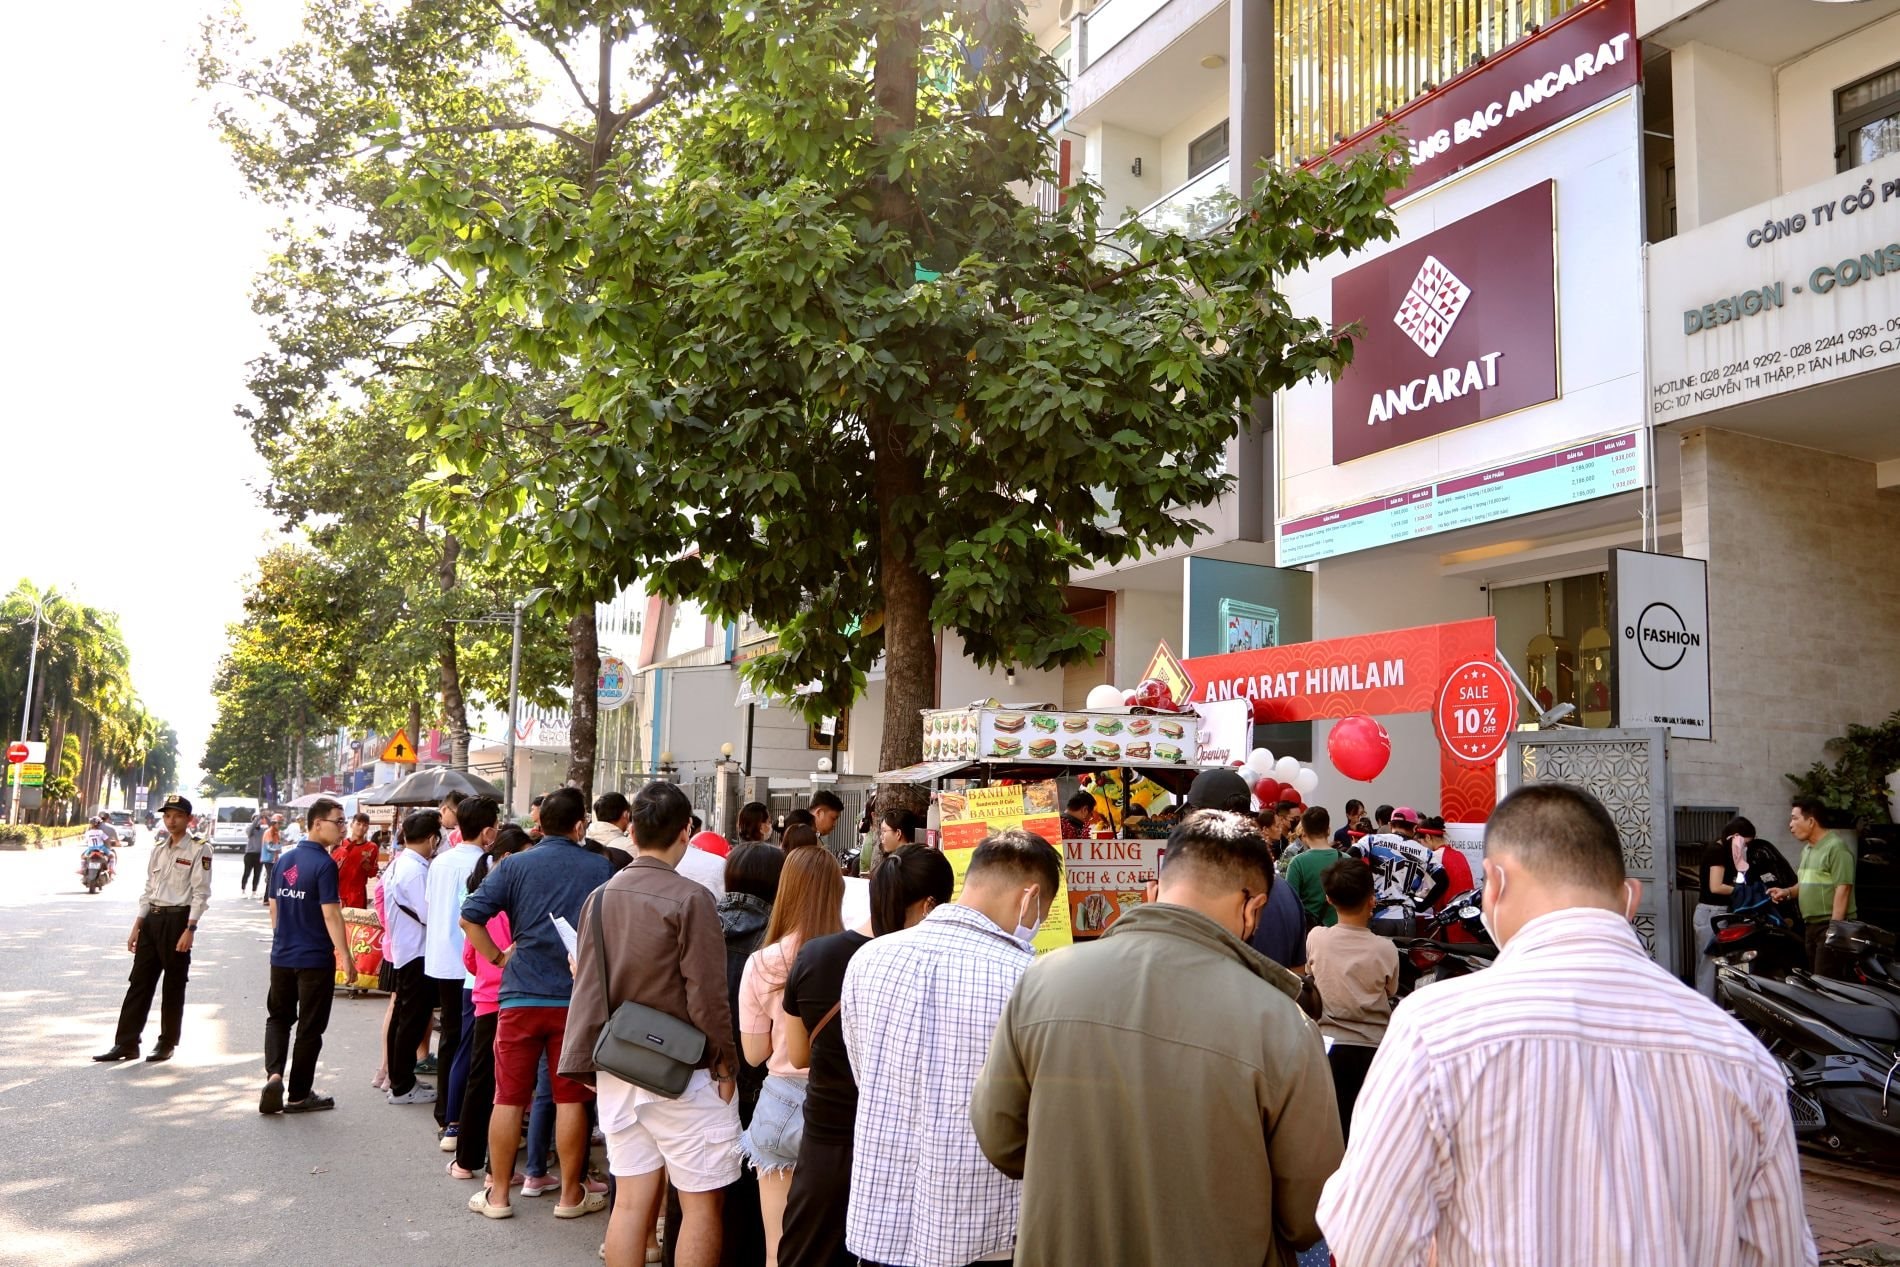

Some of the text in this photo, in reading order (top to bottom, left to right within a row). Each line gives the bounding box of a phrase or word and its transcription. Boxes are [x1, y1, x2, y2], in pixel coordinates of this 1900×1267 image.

[1454, 102, 1503, 144] BẠC
[1506, 32, 1629, 117] ANCARAT
[1747, 214, 1806, 248] CÔNG
[1812, 201, 1836, 225] TY
[1841, 178, 1875, 215] CỔ
[1684, 281, 1784, 335] DESIGN
[1809, 243, 1900, 294] CONS
[1654, 376, 1697, 397] HOTLINE:
[1700, 369, 1720, 383] 028
[1723, 360, 1749, 377] 2244
[1753, 351, 1781, 369] 9292
[1790, 342, 1812, 359] 028
[1815, 333, 1844, 352] 2244
[1848, 324, 1877, 342] 9393
[1654, 399, 1674, 414] ĐC:
[1676, 394, 1691, 408] 107
[1694, 379, 1741, 403] NGUYỄN
[1744, 375, 1760, 389] THỊ
[1763, 366, 1795, 384] THẬP,
[1808, 356, 1832, 372] TÂN
[1367, 352, 1504, 426] ANCARAT
[1643, 628, 1700, 646] FASHION
[1206, 659, 1405, 703] ANCARAT HIMLAM
[1460, 686, 1488, 699] SALE
[1090, 843, 1141, 860] KING
[1379, 840, 1421, 855] SANG HENRY
[1101, 871, 1110, 883] &
